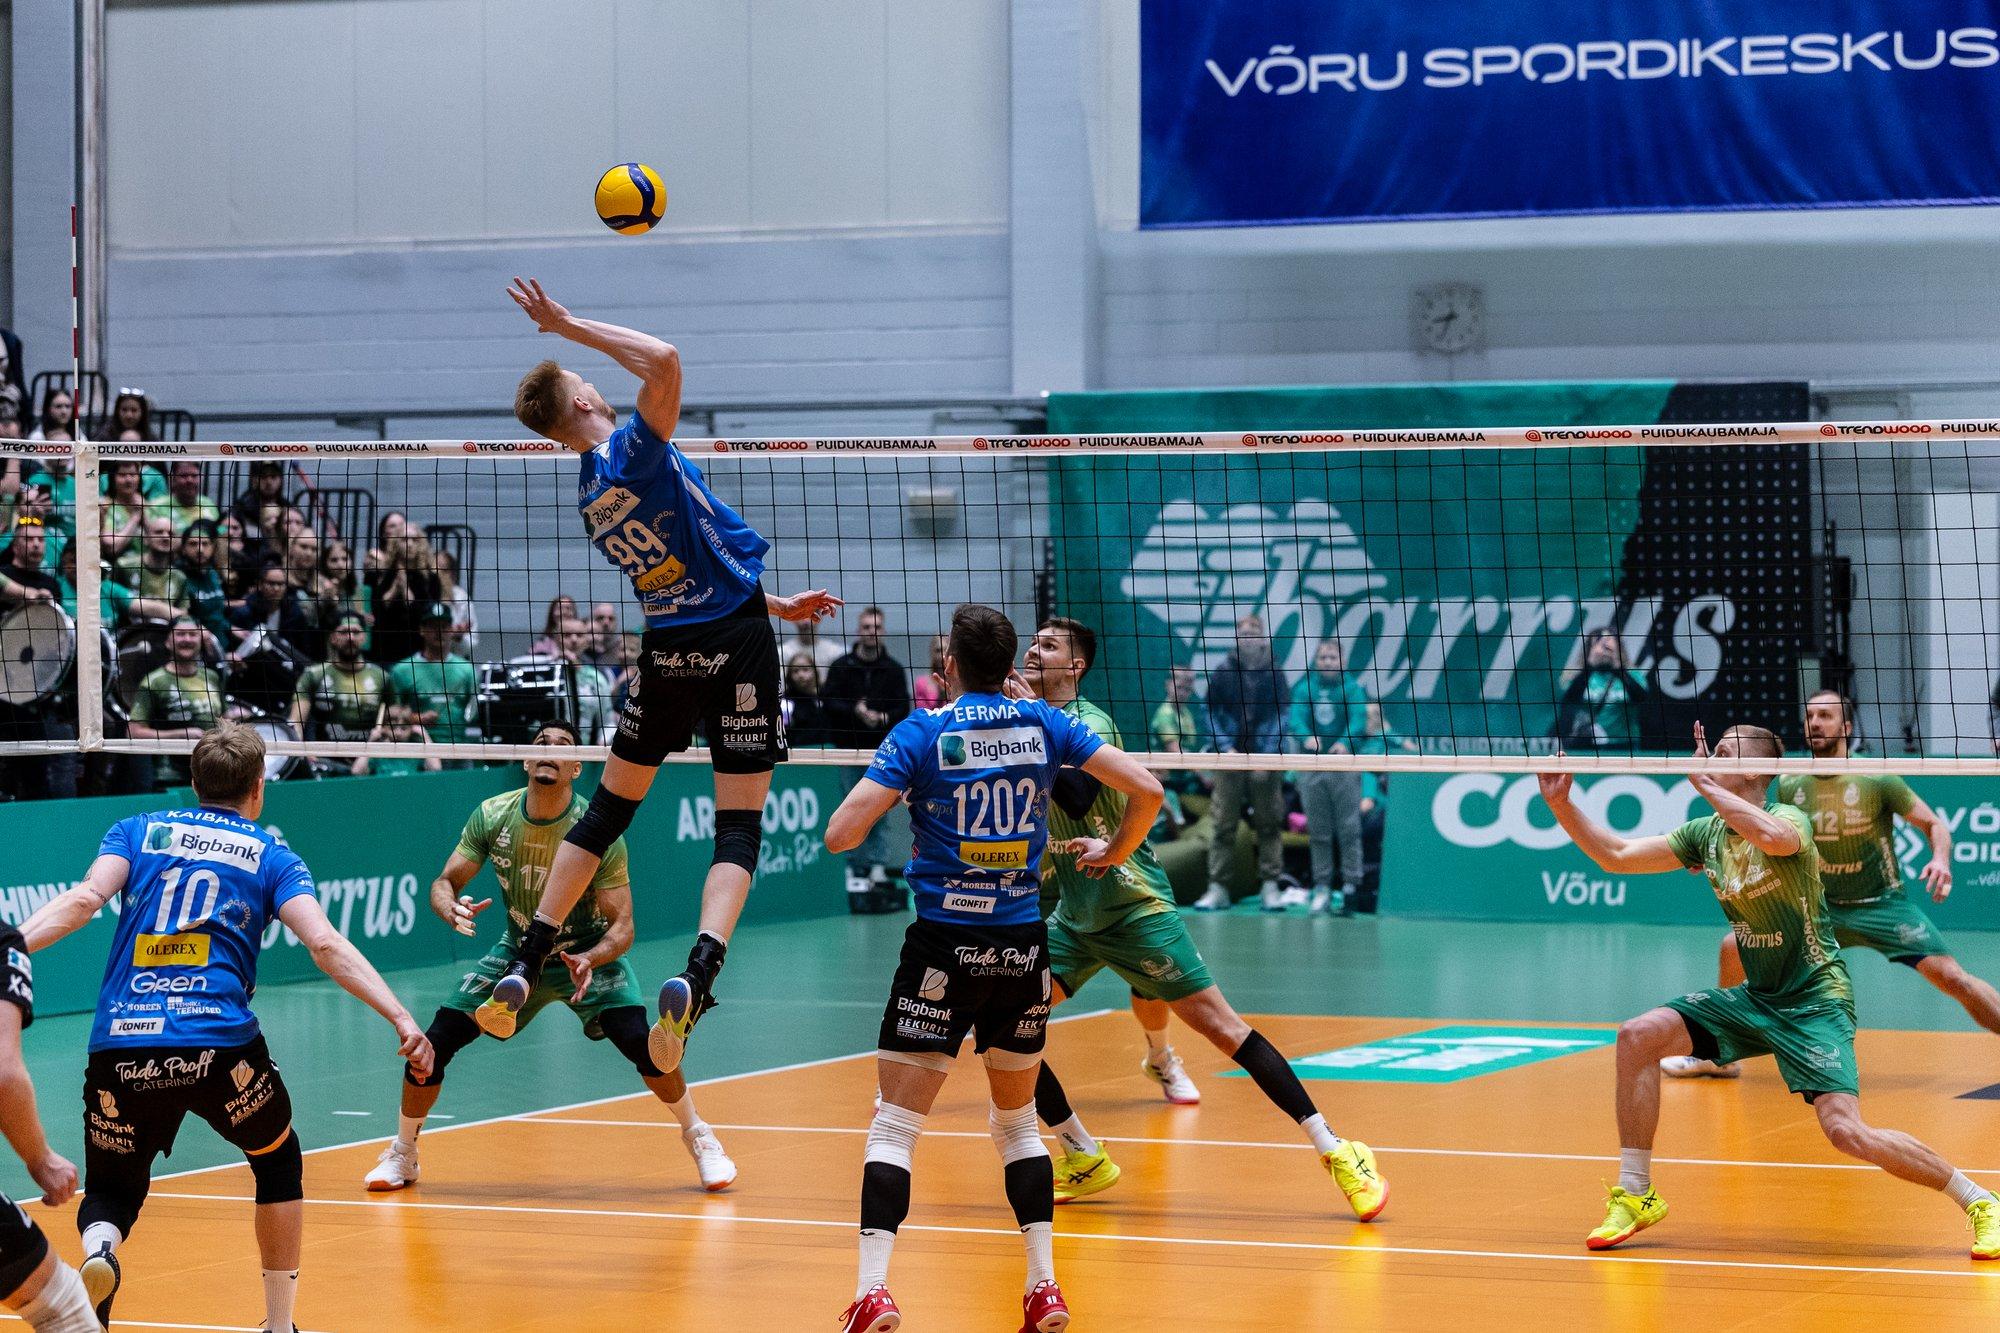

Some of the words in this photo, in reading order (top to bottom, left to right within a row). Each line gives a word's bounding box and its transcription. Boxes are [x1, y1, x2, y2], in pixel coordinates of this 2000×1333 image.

[1204, 45, 1408, 97] VÕRU
[1423, 27, 2000, 88] SPORDIKESKUS
[1352, 431, 1486, 443] PUIDUKAUBAMAJA
[1641, 426, 1779, 438] PUIDUKAUBAMAJA
[1941, 422, 2000, 433] PUIDUK
[97, 444, 188, 455] DUKAUBAMAJA
[315, 443, 430, 453] PUIDUKAUBAMAJA
[815, 439, 937, 450] PUIDUKAUBAMAJA
[1078, 436, 1204, 447] PUIDUKAUBAMAJA
[605, 519, 668, 577] 99
[643, 566, 678, 591] OLEREX
[661, 668, 707, 678] CATERING
[721, 714, 769, 731] Bigbank
[953, 704, 1021, 723] EERMA
[971, 736, 1043, 762] Bigbank
[676, 786, 820, 843] AROOD
[953, 778, 1036, 836] 1202
[1811, 810, 1839, 834] 12
[180, 832, 260, 863] Bigbank
[970, 850, 1020, 863] OLEREX
[520, 864, 548, 891] 17
[961, 881, 996, 891] MOREEN
[1541, 869, 1627, 906] Võru
[154, 866, 220, 932] 10
[146, 942, 197, 956] OLEREX
[1001, 944, 1040, 972] Proff
[970, 966, 1024, 977] CATERING
[459, 972, 494, 995] 17
[175, 1006, 222, 1015] TEENUSED
[897, 996, 953, 1021] Bigbank
[897, 1016, 950, 1036] SEKURIT
[163, 1049, 216, 1078] Proff
[133, 1075, 196, 1092] CATERING
